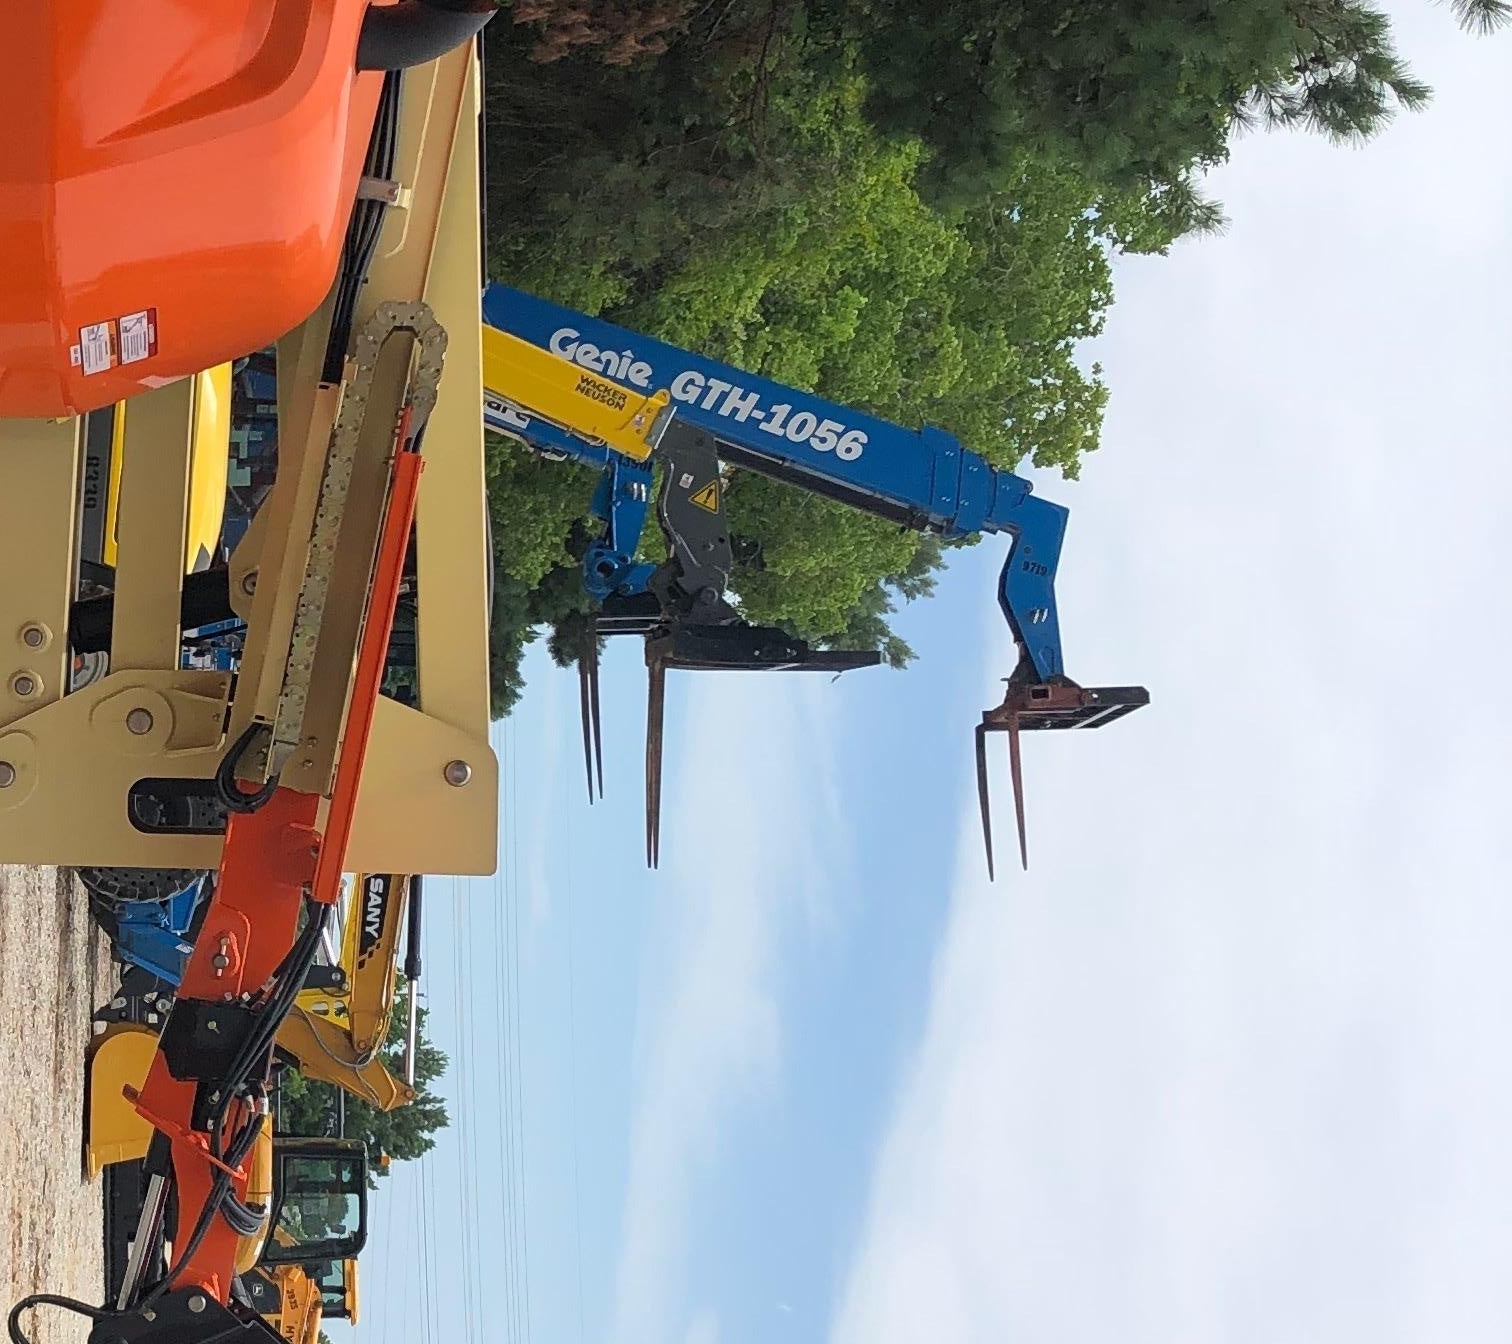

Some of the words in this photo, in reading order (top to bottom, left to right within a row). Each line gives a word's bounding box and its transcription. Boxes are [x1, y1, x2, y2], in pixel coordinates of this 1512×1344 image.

[549, 328, 653, 387] Genie
[670, 370, 868, 461] GTH-1056
[574, 383, 626, 411] NEUSON
[365, 878, 384, 938] SANY
